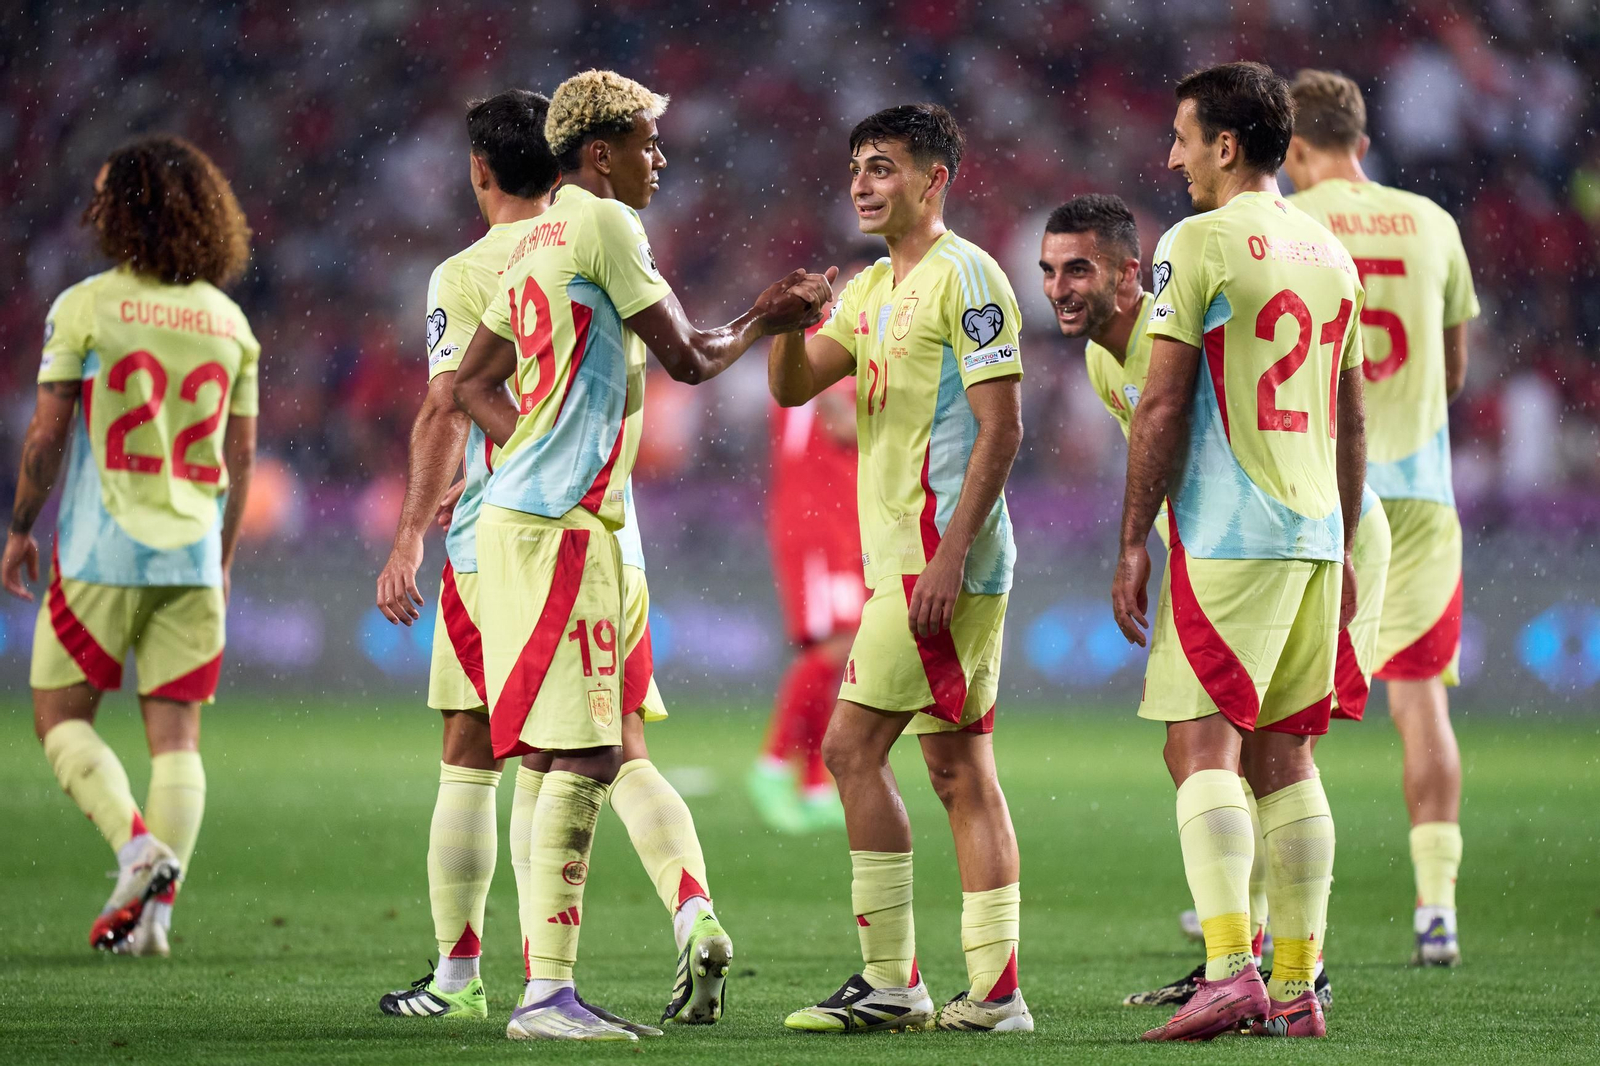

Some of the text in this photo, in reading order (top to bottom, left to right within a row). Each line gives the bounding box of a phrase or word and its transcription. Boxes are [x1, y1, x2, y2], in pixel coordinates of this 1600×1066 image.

[1327, 213, 1417, 236] HUIJSEN
[119, 300, 237, 339] CUCURELLA
[508, 275, 556, 415] 19
[1255, 288, 1353, 440] 21
[1352, 257, 1409, 382] 5
[105, 350, 230, 485] 22
[568, 619, 617, 677] 19
